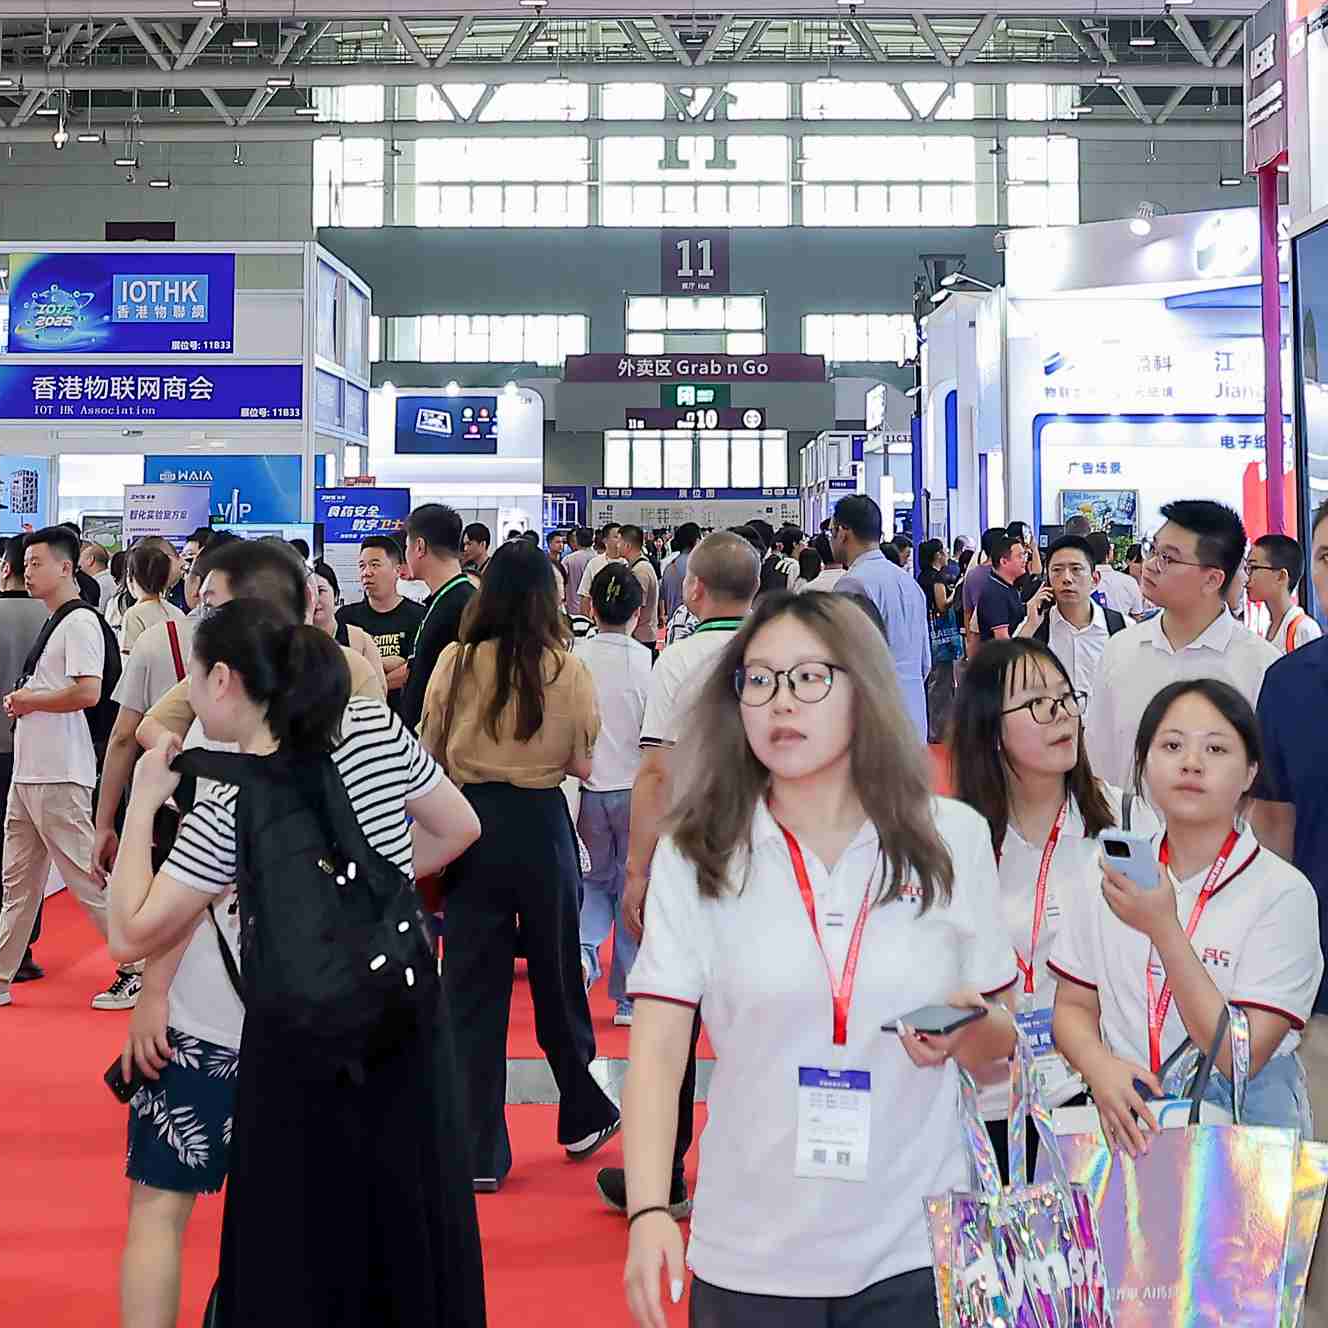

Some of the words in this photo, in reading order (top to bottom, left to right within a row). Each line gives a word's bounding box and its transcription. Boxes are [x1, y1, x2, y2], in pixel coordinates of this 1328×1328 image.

[676, 239, 715, 277] 11
[122, 280, 198, 303] IOTHK
[34, 315, 73, 328] 2025
[617, 358, 673, 377] 外卖区
[676, 359, 722, 376] Grab
[726, 362, 738, 376] n
[742, 359, 769, 376] Go
[32, 375, 215, 401] 香港物联网商会
[33, 404, 55, 415] IOT
[79, 404, 157, 416] Association
[1067, 461, 1122, 475] 广告场景
